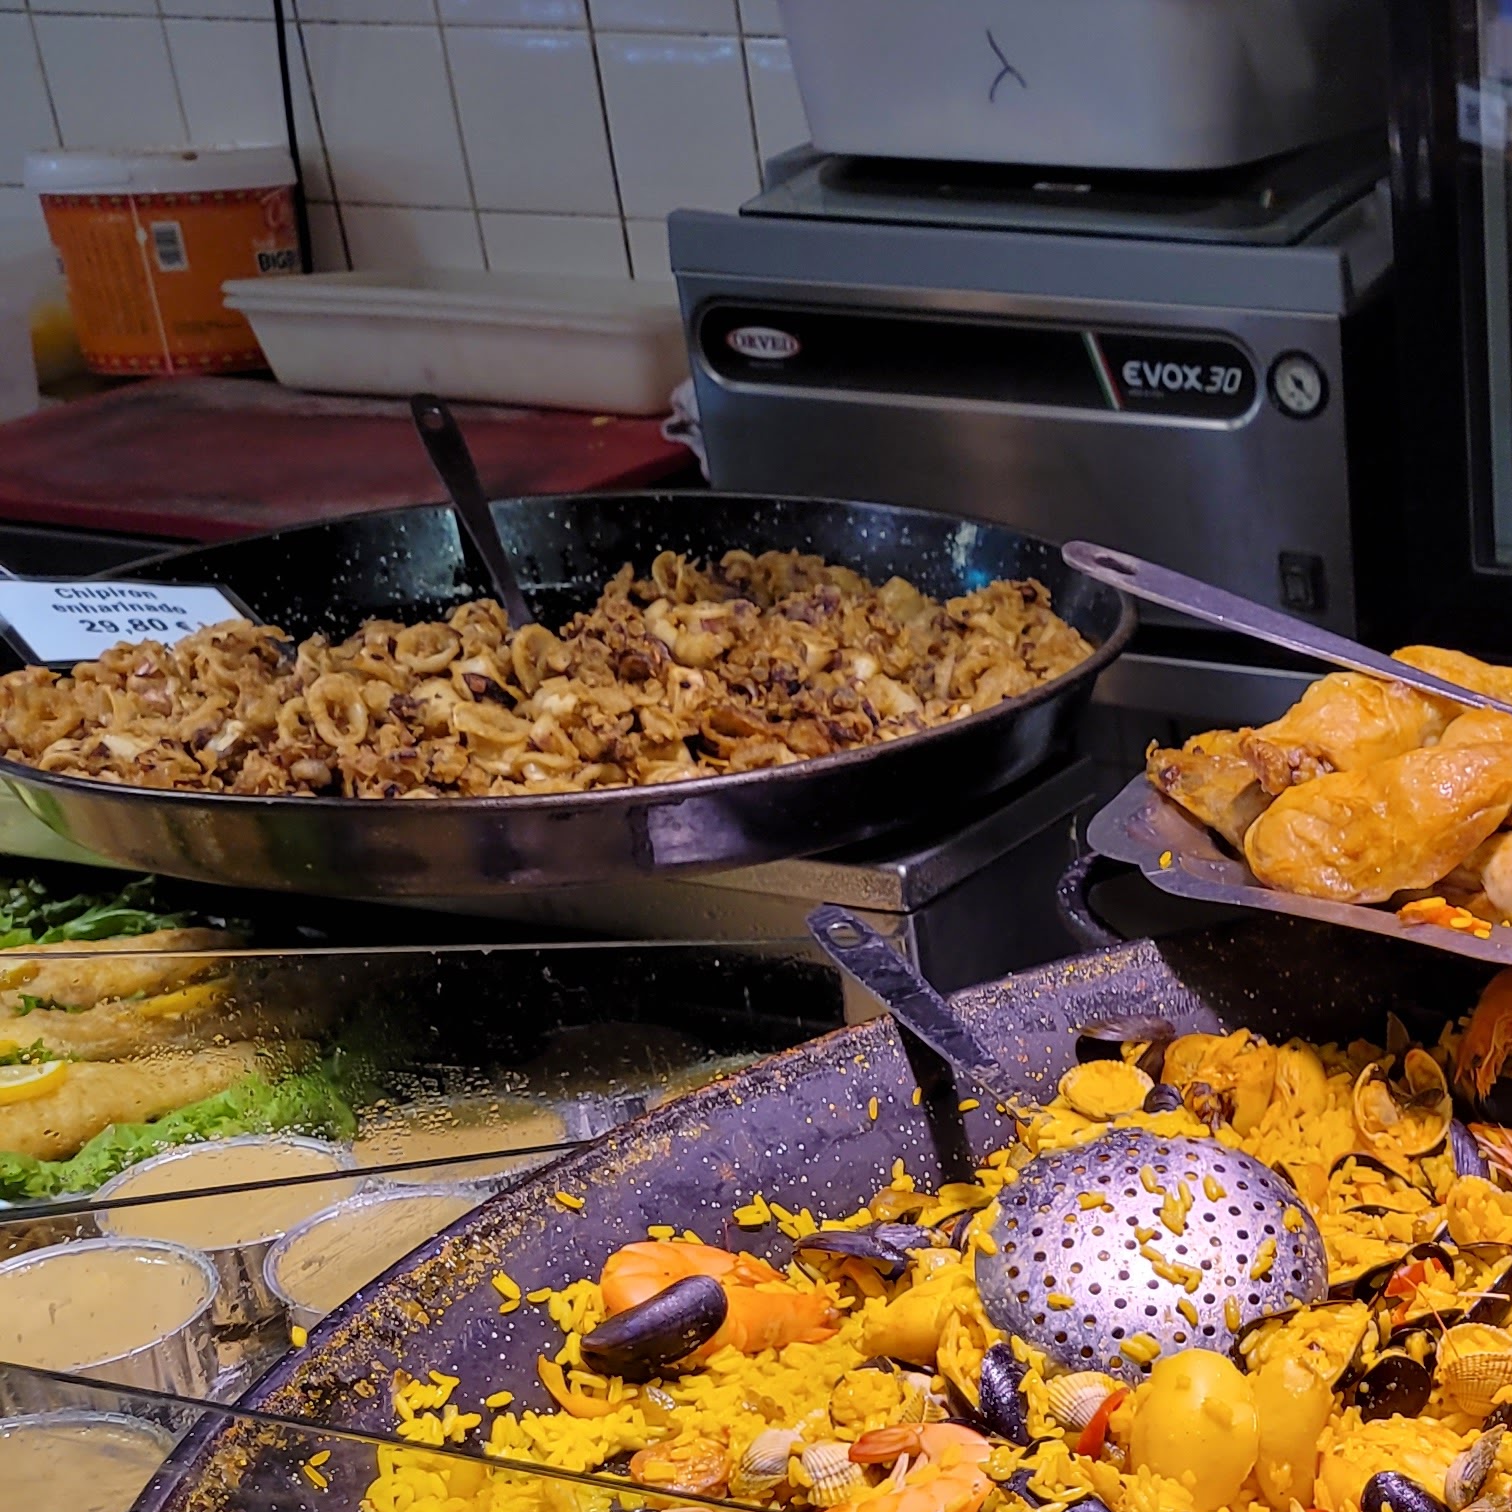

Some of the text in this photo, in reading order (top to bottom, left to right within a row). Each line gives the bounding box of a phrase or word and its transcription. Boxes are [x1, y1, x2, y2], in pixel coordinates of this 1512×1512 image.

[1122, 360, 1243, 394] EVOX 30
[54, 587, 158, 600] Chipiron
[52, 603, 188, 615] enharinado
[79, 618, 169, 635] 29,80
